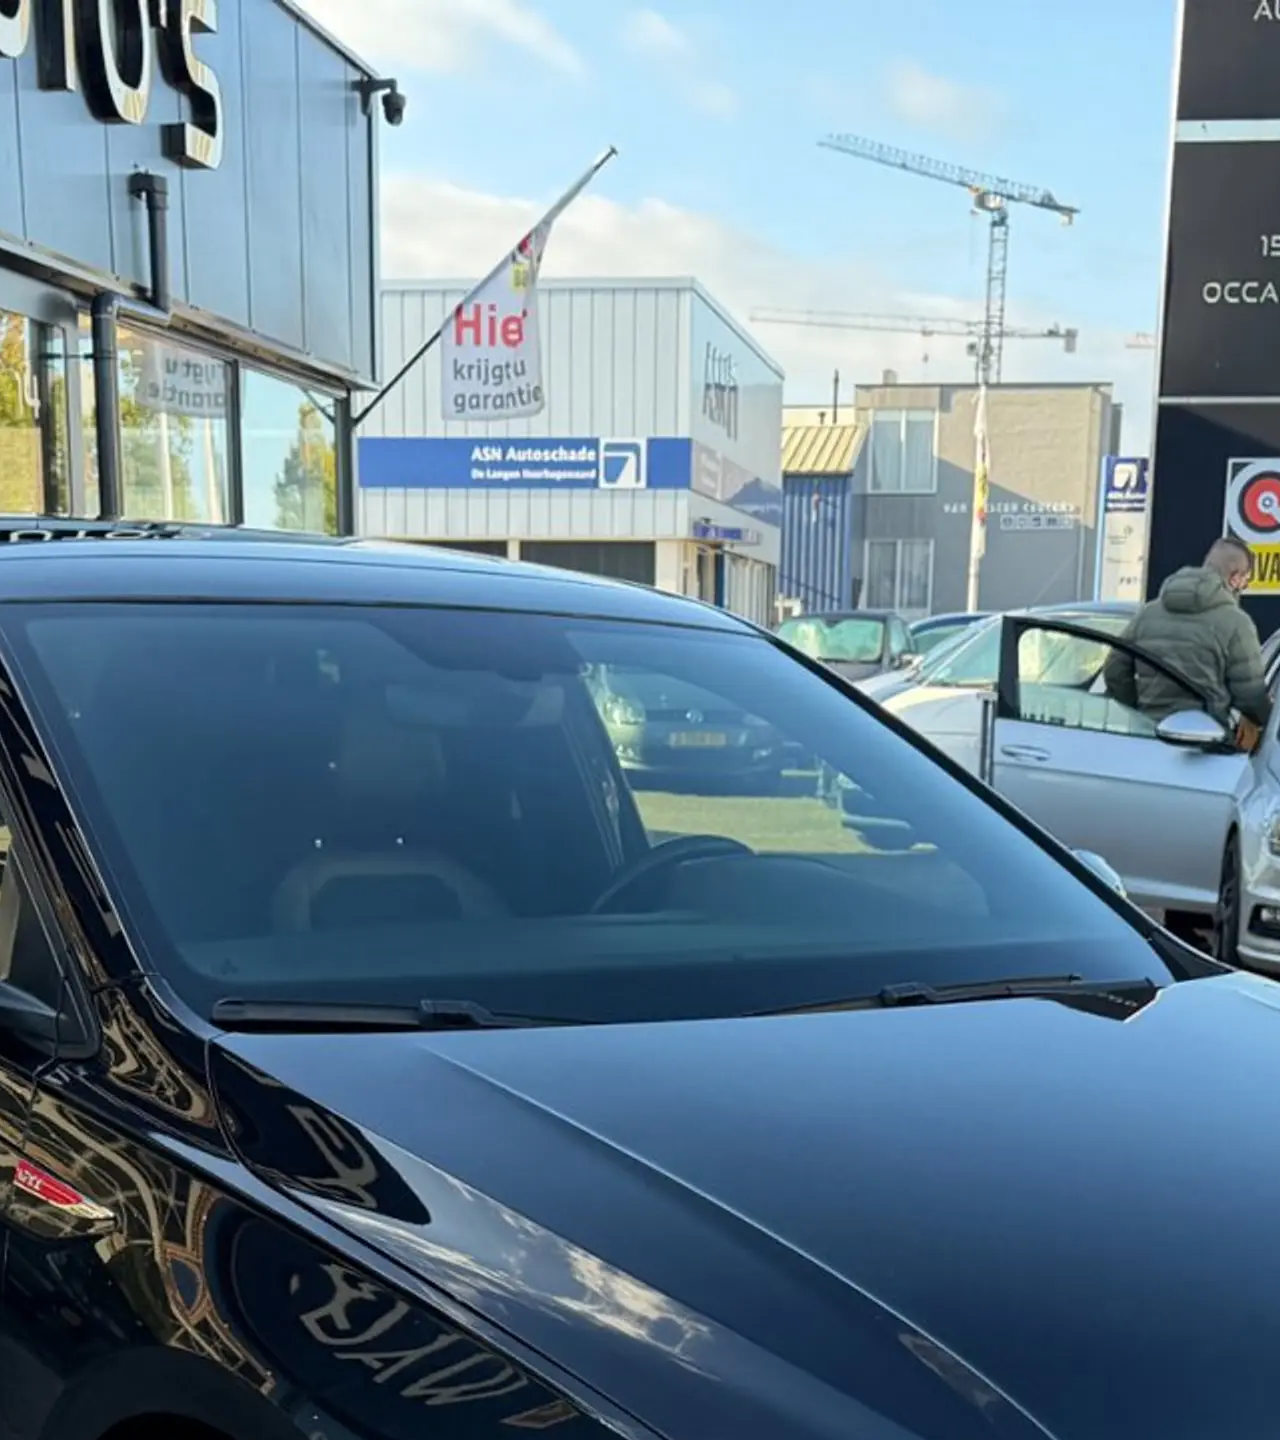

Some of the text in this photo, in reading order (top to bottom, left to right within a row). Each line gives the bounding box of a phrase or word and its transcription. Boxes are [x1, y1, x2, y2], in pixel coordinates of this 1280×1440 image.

[453, 358, 526, 385] krijgt u
[453, 383, 543, 413] garantie
[471, 445, 597, 462] ASN Autoschade
